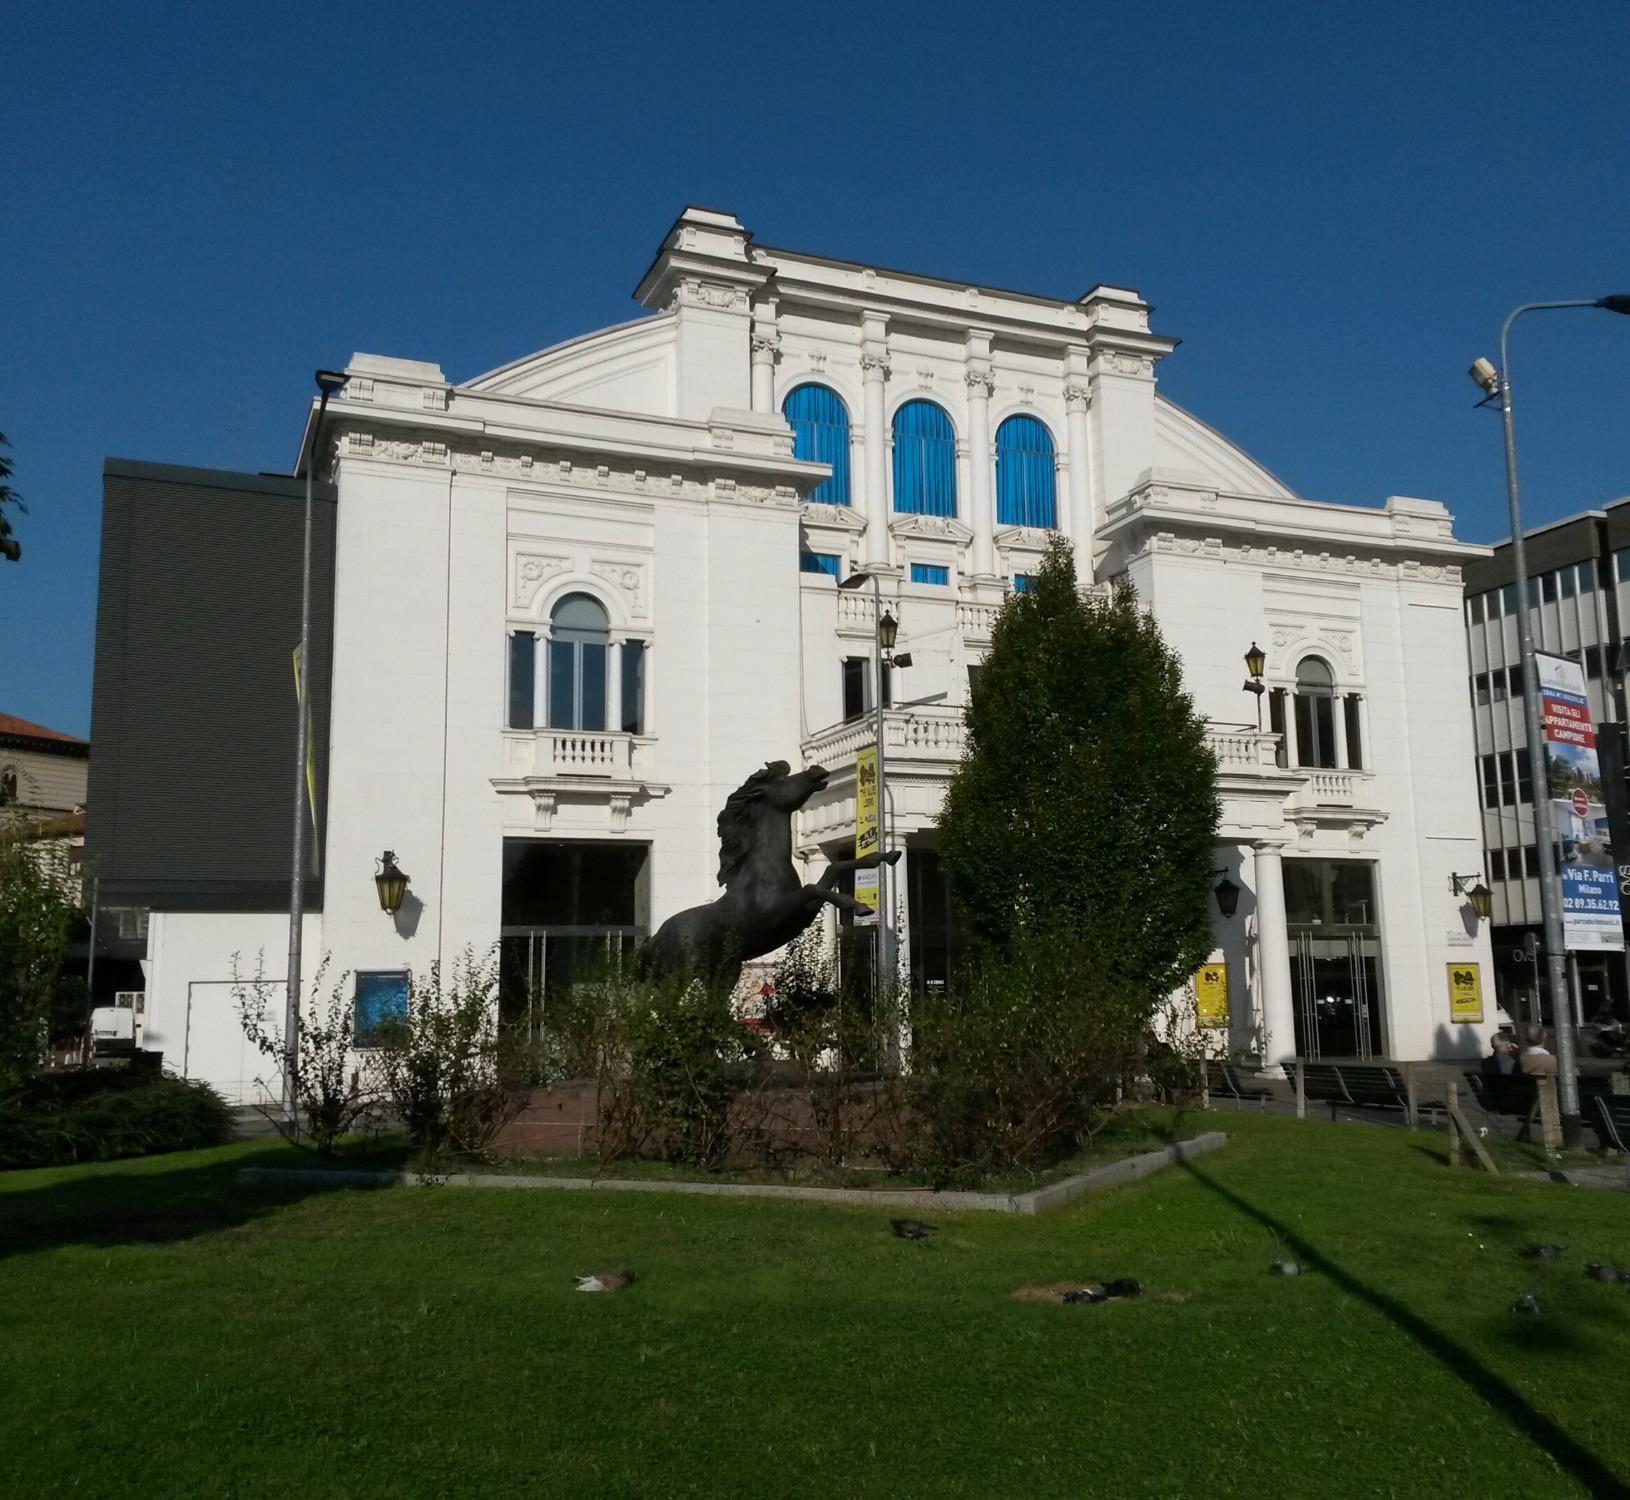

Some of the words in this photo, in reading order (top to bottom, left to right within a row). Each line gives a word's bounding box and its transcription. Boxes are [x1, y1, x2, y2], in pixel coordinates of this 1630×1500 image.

[1552, 704, 1571, 716] VISITA
[1571, 708, 1581, 718] GLI
[1545, 715, 1592, 732] APPARTAMENTI
[1554, 729, 1585, 743] CAMPIONE
[1567, 868, 1583, 881] Via
[1584, 869, 1592, 882] F.
[1592, 870, 1614, 883] Parri
[1578, 884, 1602, 895] Milano
[1564, 898, 1574, 908] 02
